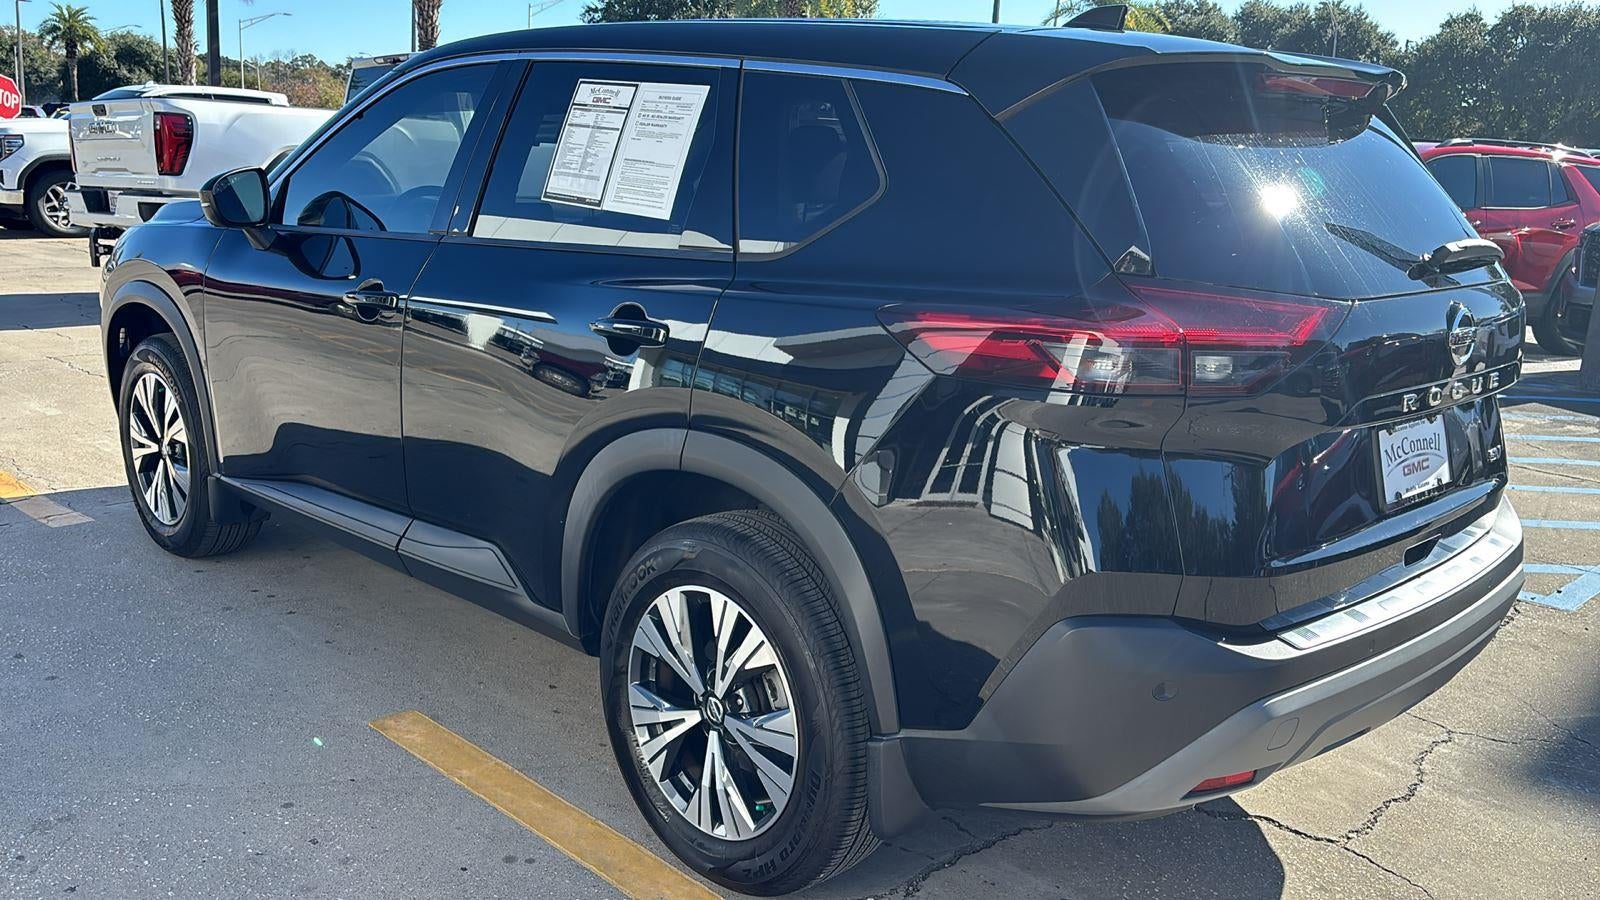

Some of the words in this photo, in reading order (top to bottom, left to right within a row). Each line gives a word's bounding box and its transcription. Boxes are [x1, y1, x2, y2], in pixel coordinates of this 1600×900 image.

[0, 88, 19, 109] TOP
[1402, 371, 1500, 413] ROGUE
[1384, 432, 1441, 467] McConnell
[1402, 457, 1430, 477] GMC
